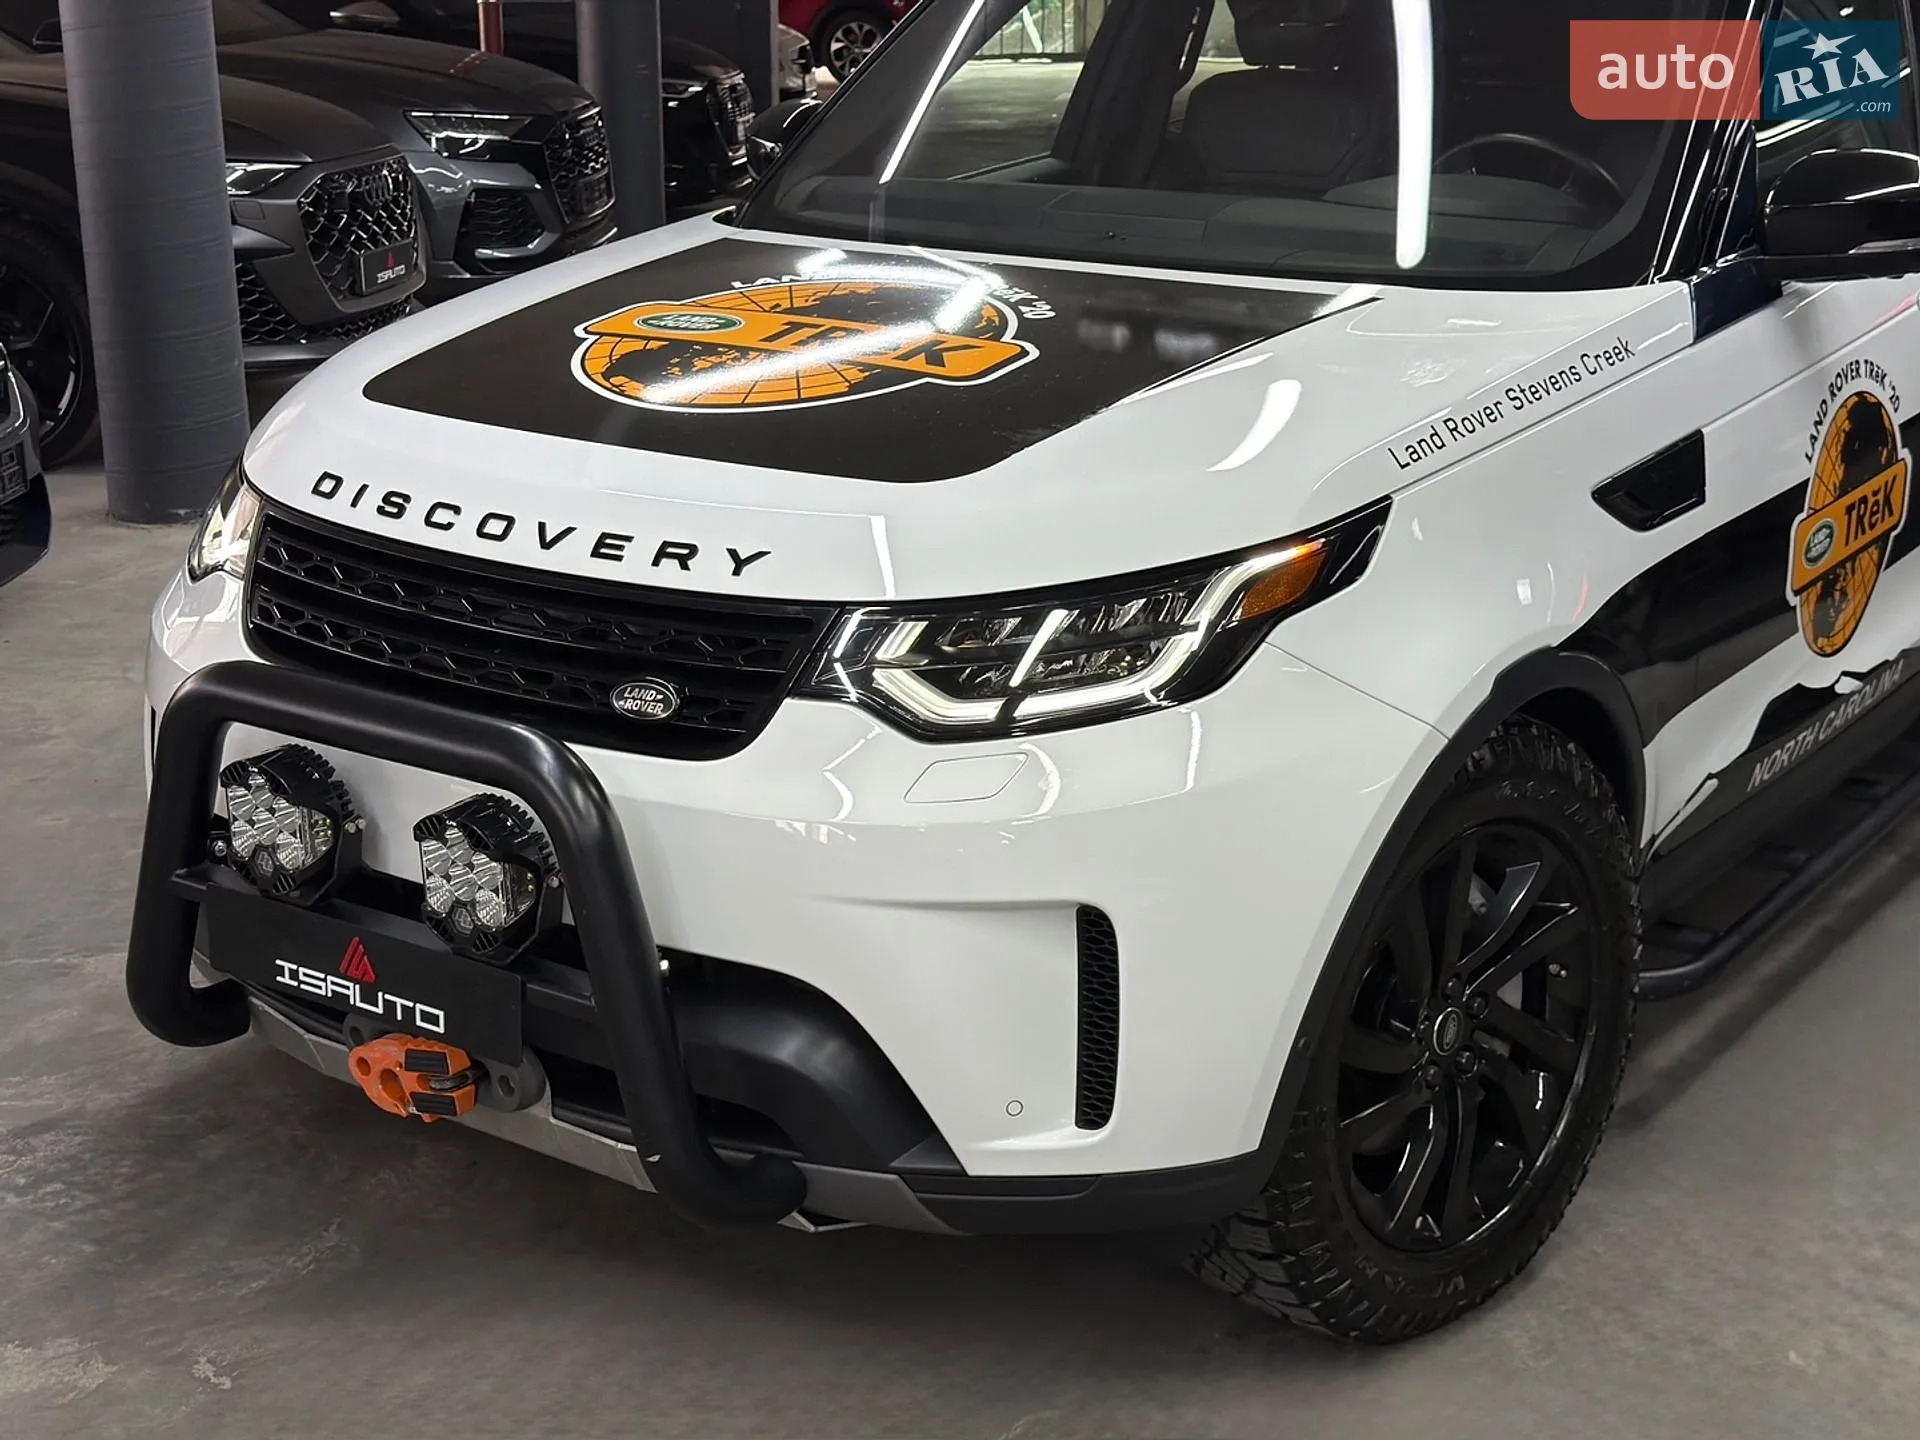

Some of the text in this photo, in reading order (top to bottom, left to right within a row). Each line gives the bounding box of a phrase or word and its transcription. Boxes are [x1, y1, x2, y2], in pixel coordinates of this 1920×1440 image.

[1388, 336, 1636, 470] Land Rover Stevens Creek
[1804, 398, 1828, 463] LAND
[1828, 359, 1862, 404] ROVER
[311, 471, 771, 576] DISCOVERY
[623, 698, 664, 714] ROVER
[624, 687, 657, 700] LAND
[1747, 658, 1904, 783] NORTH CAROLINA
[275, 959, 446, 1034] ISAUTO
